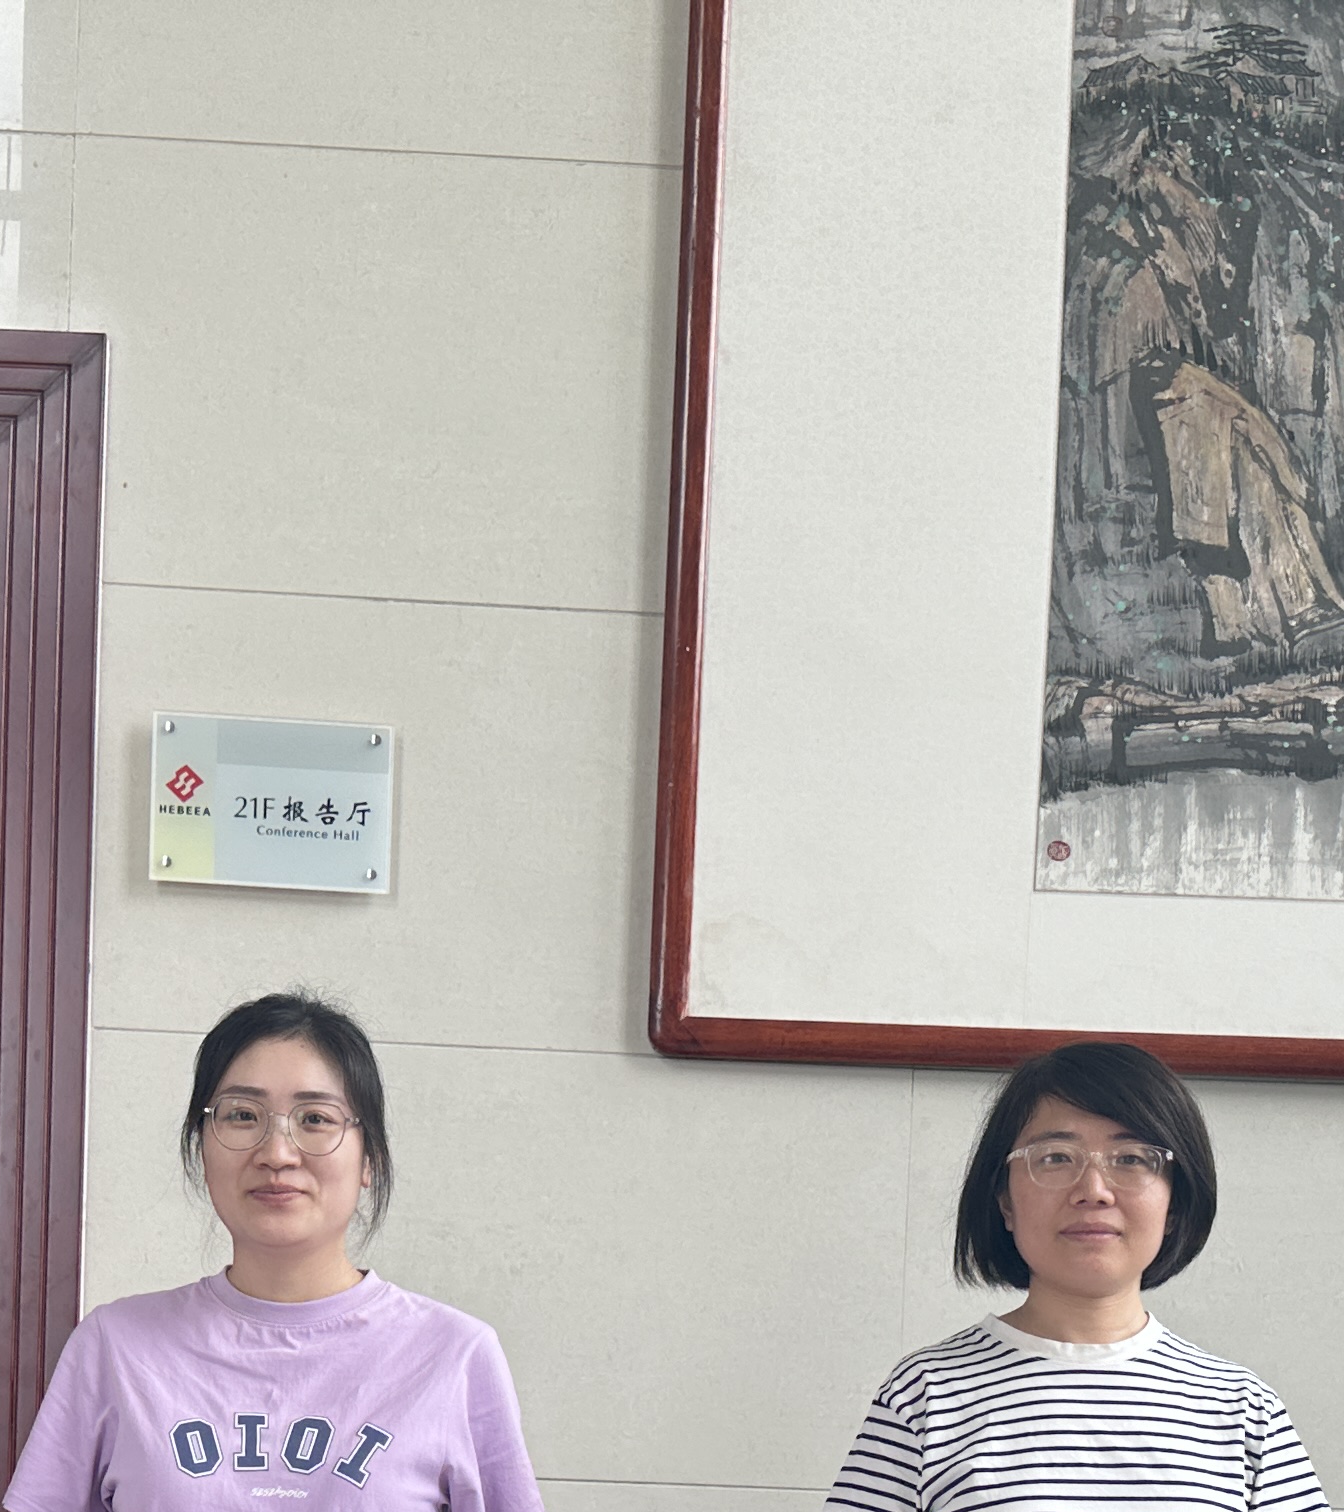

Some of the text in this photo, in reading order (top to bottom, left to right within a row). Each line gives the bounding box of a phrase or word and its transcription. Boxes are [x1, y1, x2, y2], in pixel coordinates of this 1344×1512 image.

[159, 804, 211, 817] HEBEEA
[256, 825, 360, 842] Conference Hall
